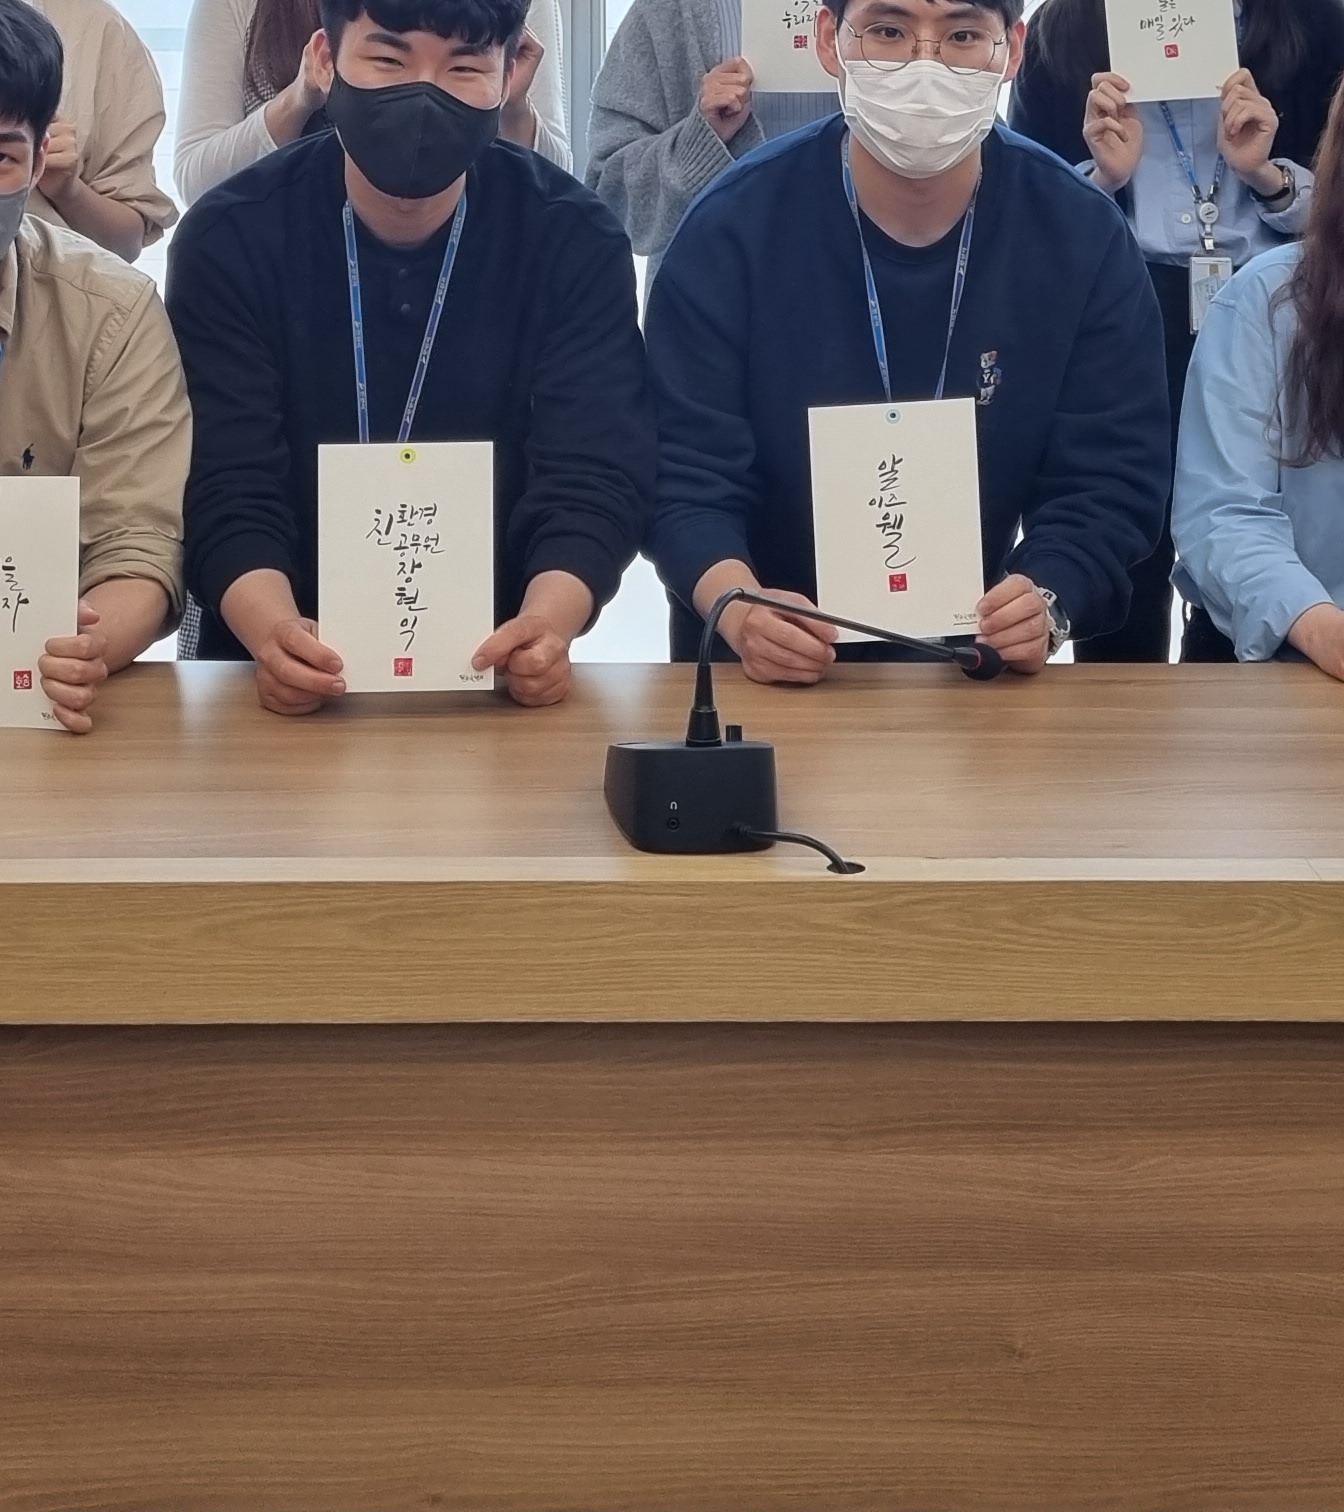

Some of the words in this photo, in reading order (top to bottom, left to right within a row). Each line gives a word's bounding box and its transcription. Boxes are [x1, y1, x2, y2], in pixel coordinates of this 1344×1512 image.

[1139, 14, 1165, 41] 매일
[868, 493, 908, 509] 이즈
[393, 532, 446, 558] 공무원
